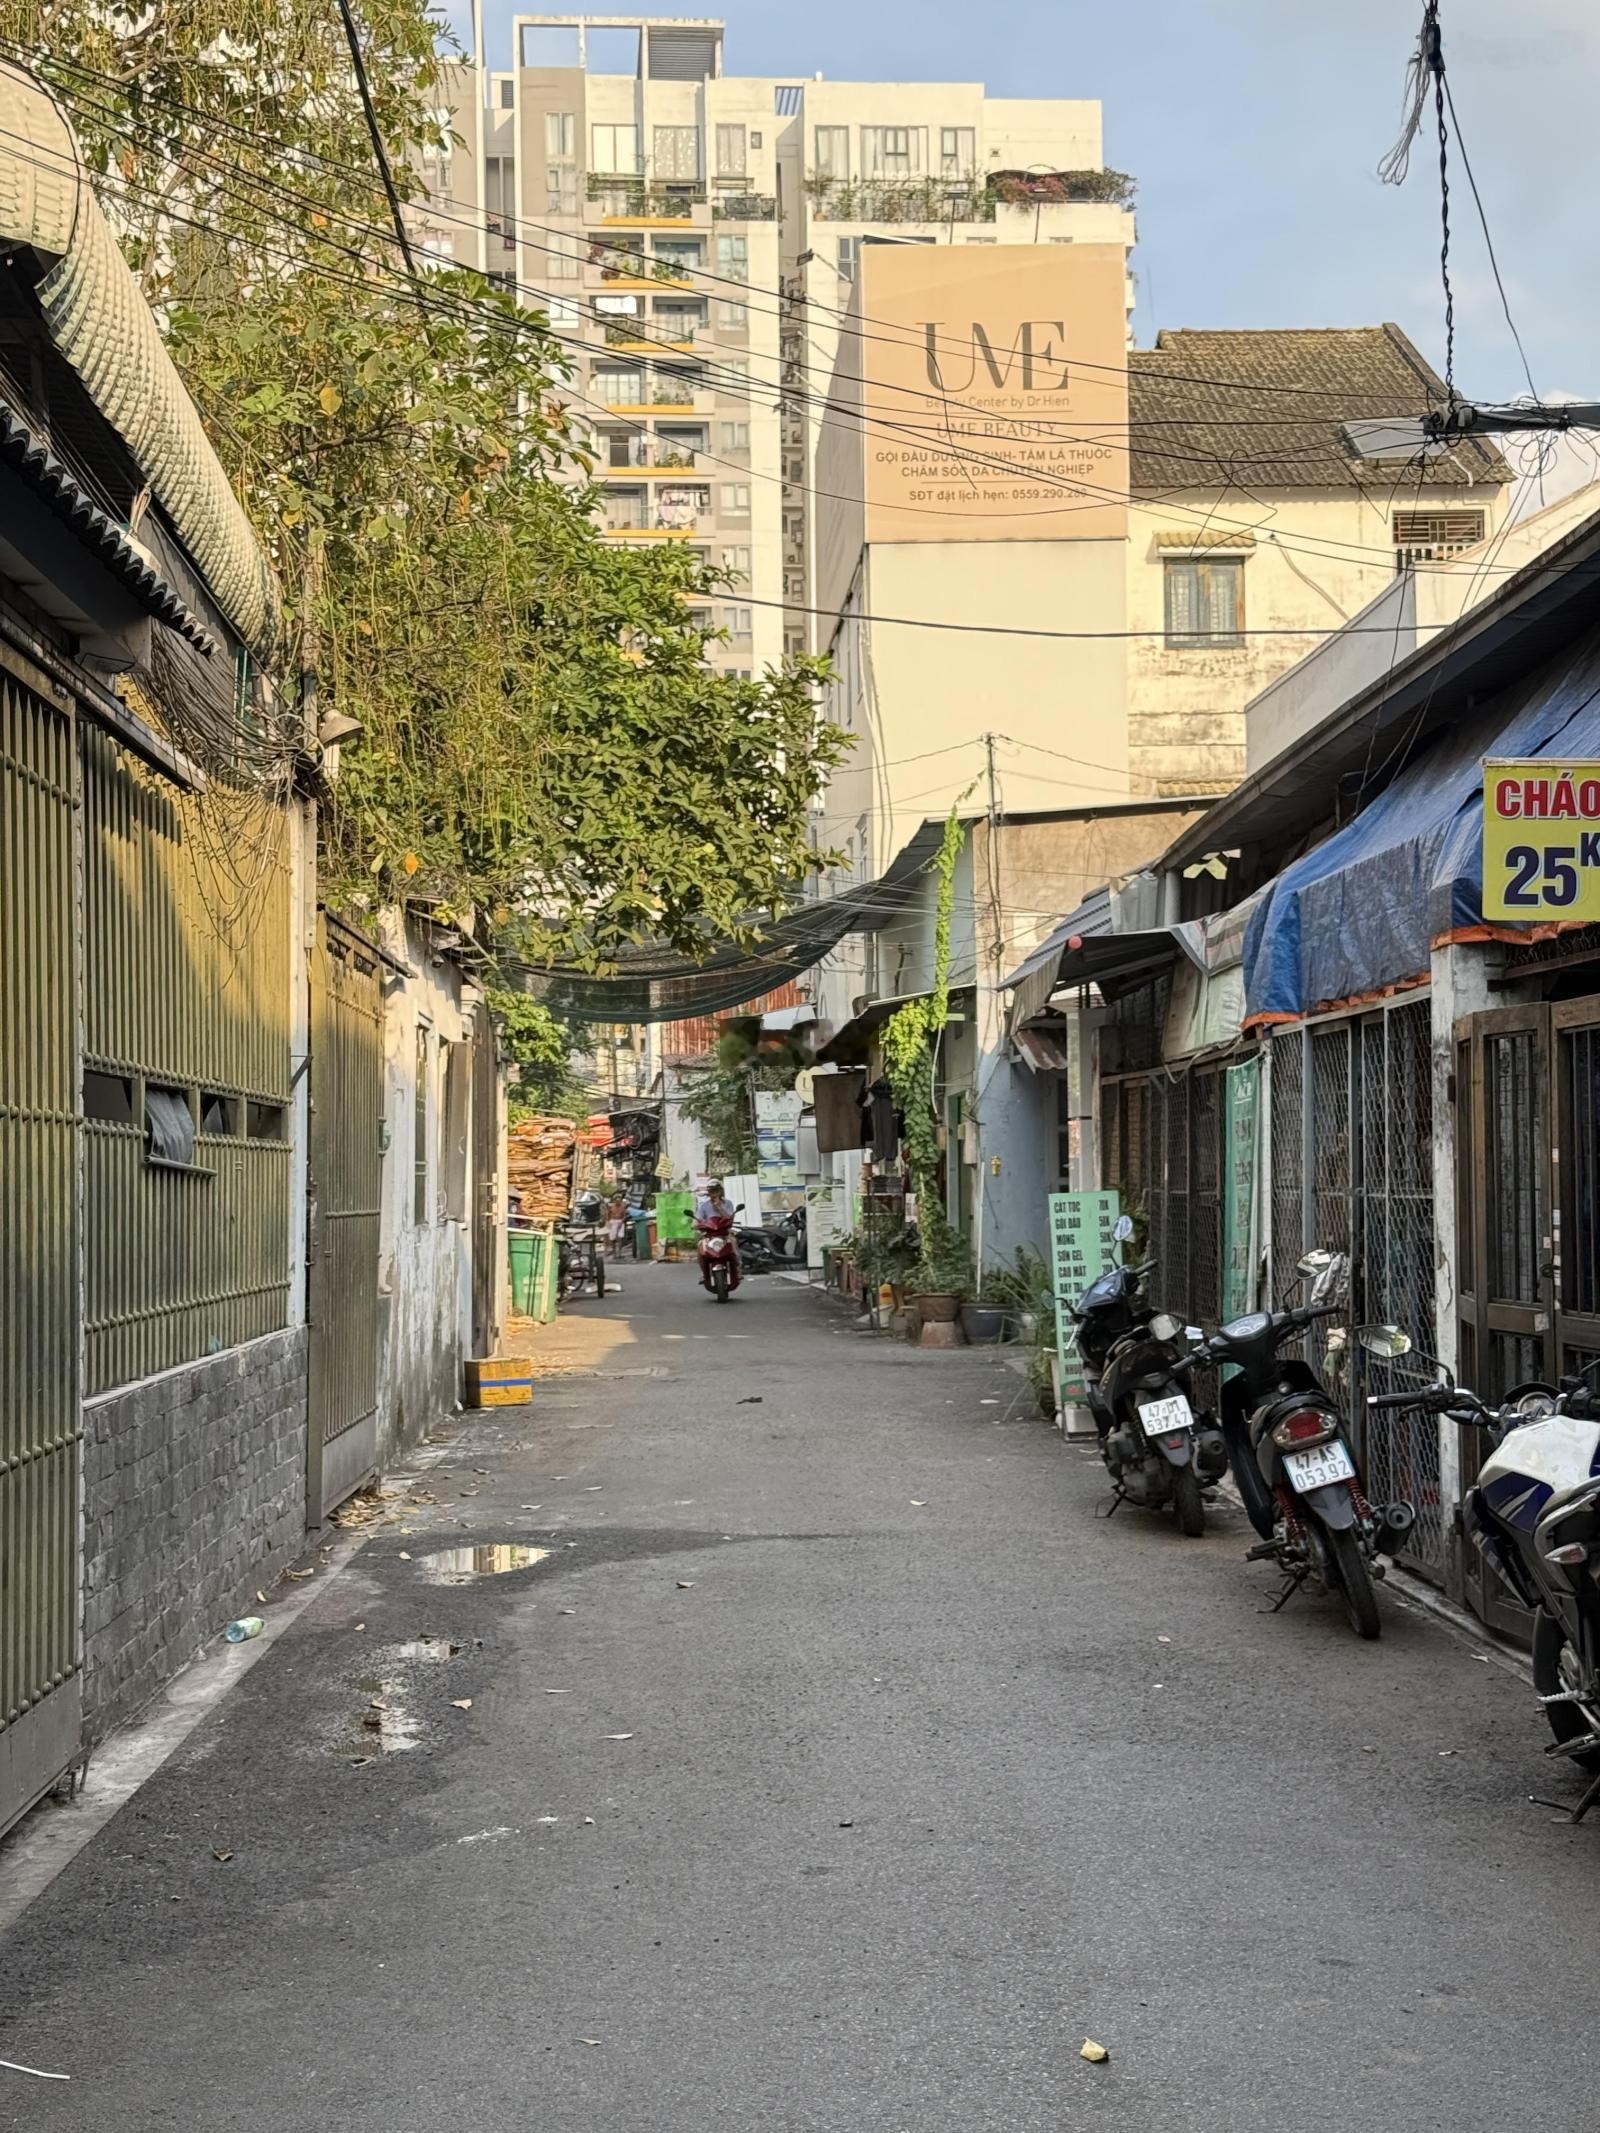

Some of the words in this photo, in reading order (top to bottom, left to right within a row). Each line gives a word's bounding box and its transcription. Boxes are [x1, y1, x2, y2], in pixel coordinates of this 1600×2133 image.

[915, 321, 1068, 392] UME
[926, 397, 967, 410] Beuty
[969, 397, 1007, 408] Center
[1010, 397, 1024, 409] by
[937, 422, 976, 438] UME
[984, 422, 1057, 438] BEAUTY
[972, 467, 989, 476] DA
[909, 490, 934, 501] SĐT
[959, 489, 979, 503] lịch
[1496, 772, 1600, 818] CHÁO
[1147, 1411, 1187, 1432] 537.47
[1295, 1461, 1349, 1488] 053.92
